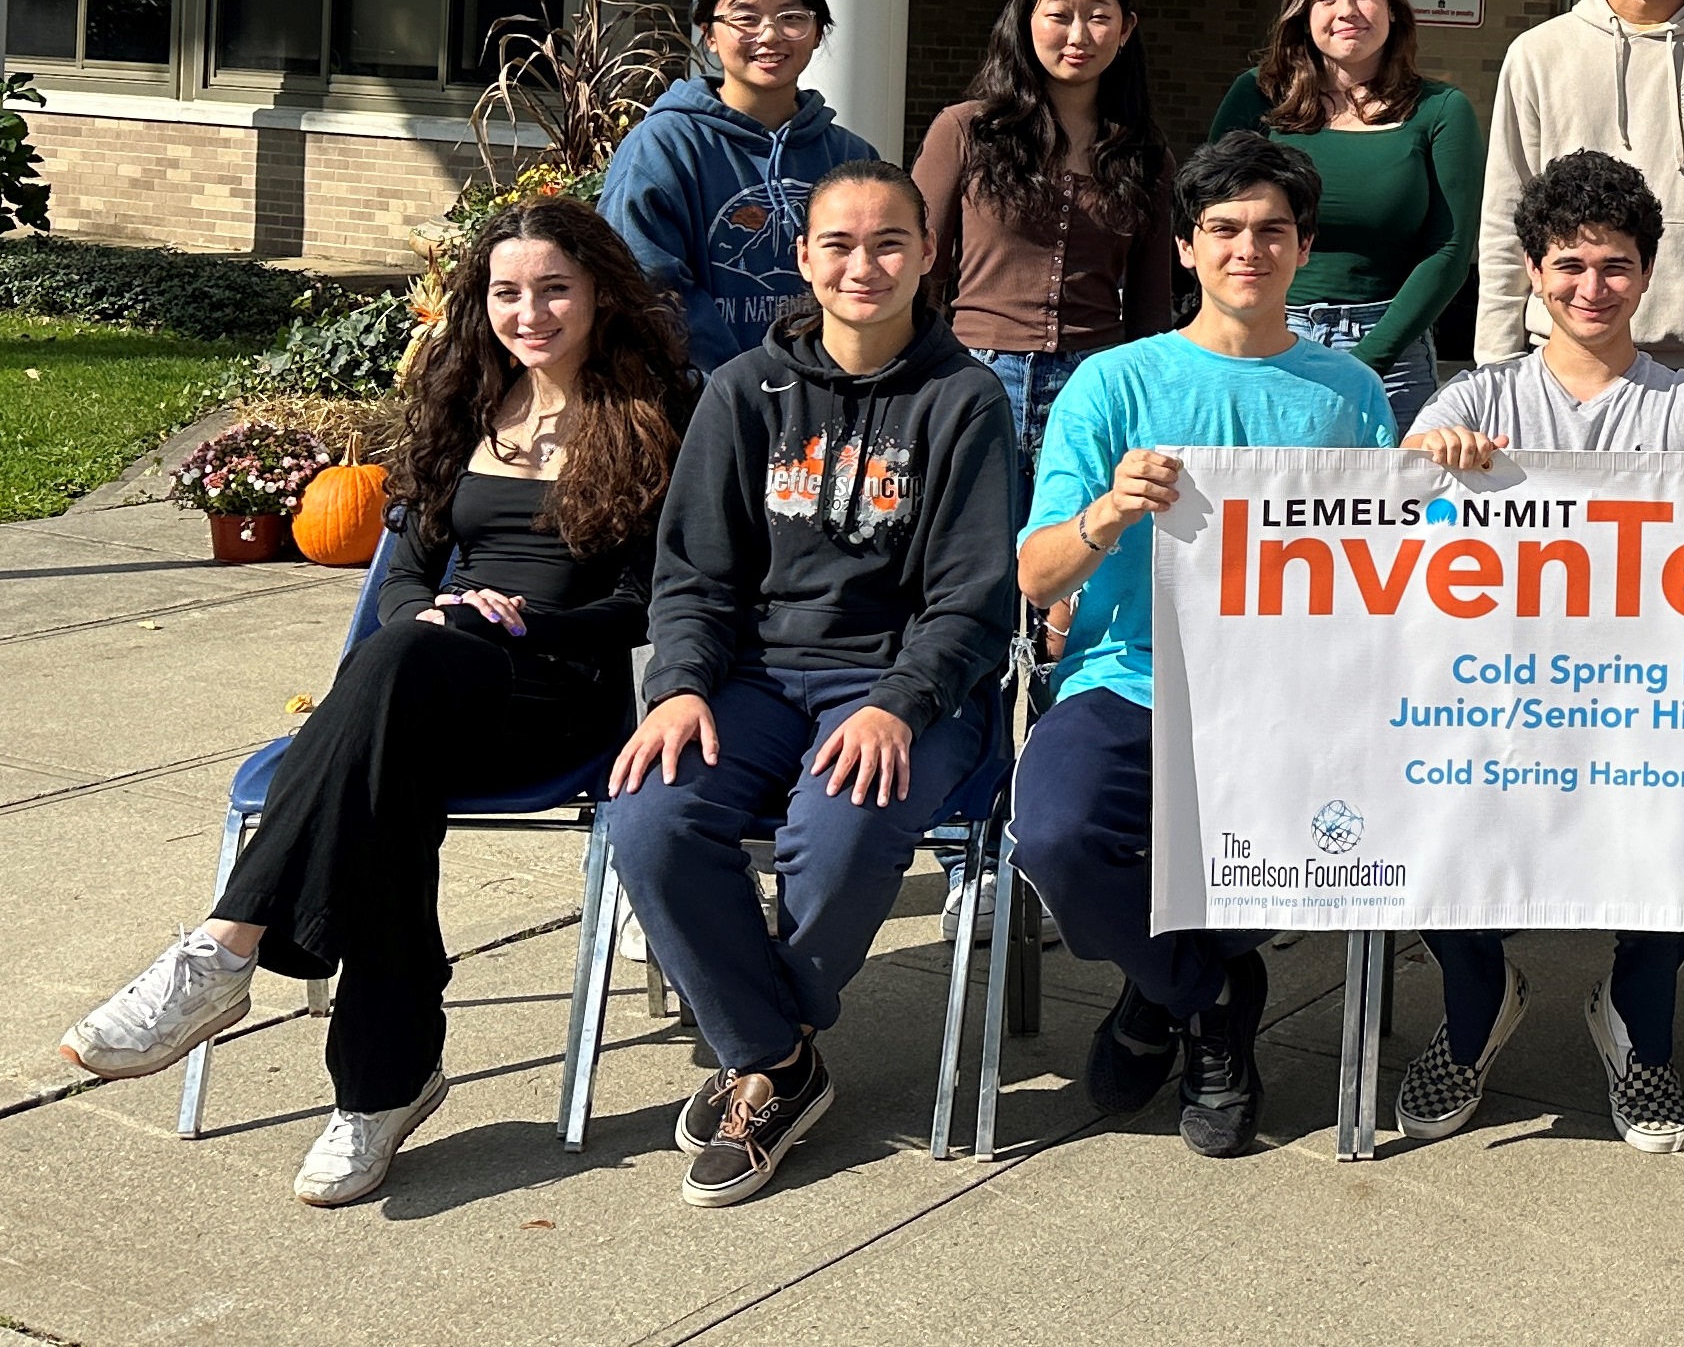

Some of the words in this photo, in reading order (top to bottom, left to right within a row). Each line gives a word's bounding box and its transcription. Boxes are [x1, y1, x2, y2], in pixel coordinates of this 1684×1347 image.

[1452, 654, 1536, 685] Cold
[1550, 655, 1668, 693] Spring
[1389, 697, 1639, 730] Junior/Senior
[1404, 759, 1472, 786] Cold
[1483, 760, 1579, 792] Spring
[1222, 832, 1250, 859] The
[1210, 857, 1299, 889] Lemelson
[1304, 857, 1406, 889] Foundation
[1210, 895, 1268, 909] improving
[1272, 895, 1298, 907] lives
[1302, 895, 1347, 909] through
[1351, 895, 1406, 907] invention
